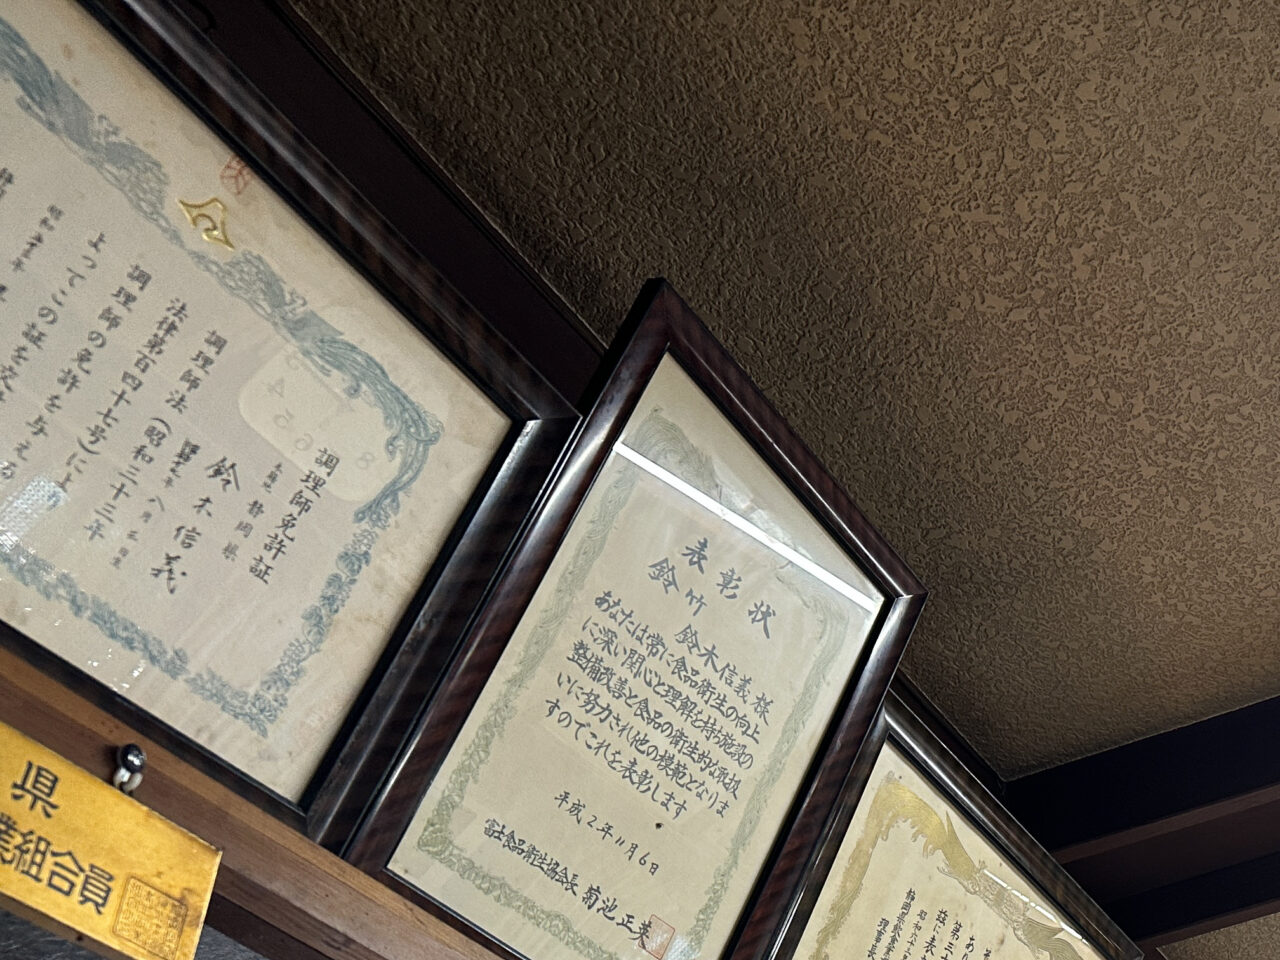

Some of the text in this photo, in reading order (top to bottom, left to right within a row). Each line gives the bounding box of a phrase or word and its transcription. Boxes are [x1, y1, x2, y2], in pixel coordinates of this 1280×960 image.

[0, 264, 152, 480] 調理師の免許を与える
[151, 456, 240, 594] 鈴木信義
[249, 446, 340, 585] 調理師免許証
[648, 557, 708, 616] 鈴竹
[682, 538, 776, 639] 表彰状
[566, 640, 742, 800] 整備改善と食品の衛生的な取扱
[582, 616, 754, 770] に深い関心と理解を持ち施設の
[595, 590, 760, 745] あなたは常に食品衛生の向上
[675, 624, 773, 726] 鈴木信義様
[11, 760, 60, 819] 県
[545, 699, 688, 820] すのでこれを表彰します
[557, 672, 731, 818] いに努力され他の模範となりま
[484, 818, 580, 896] 富士食品衛生協会長
[867, 917, 890, 960] 理事長
